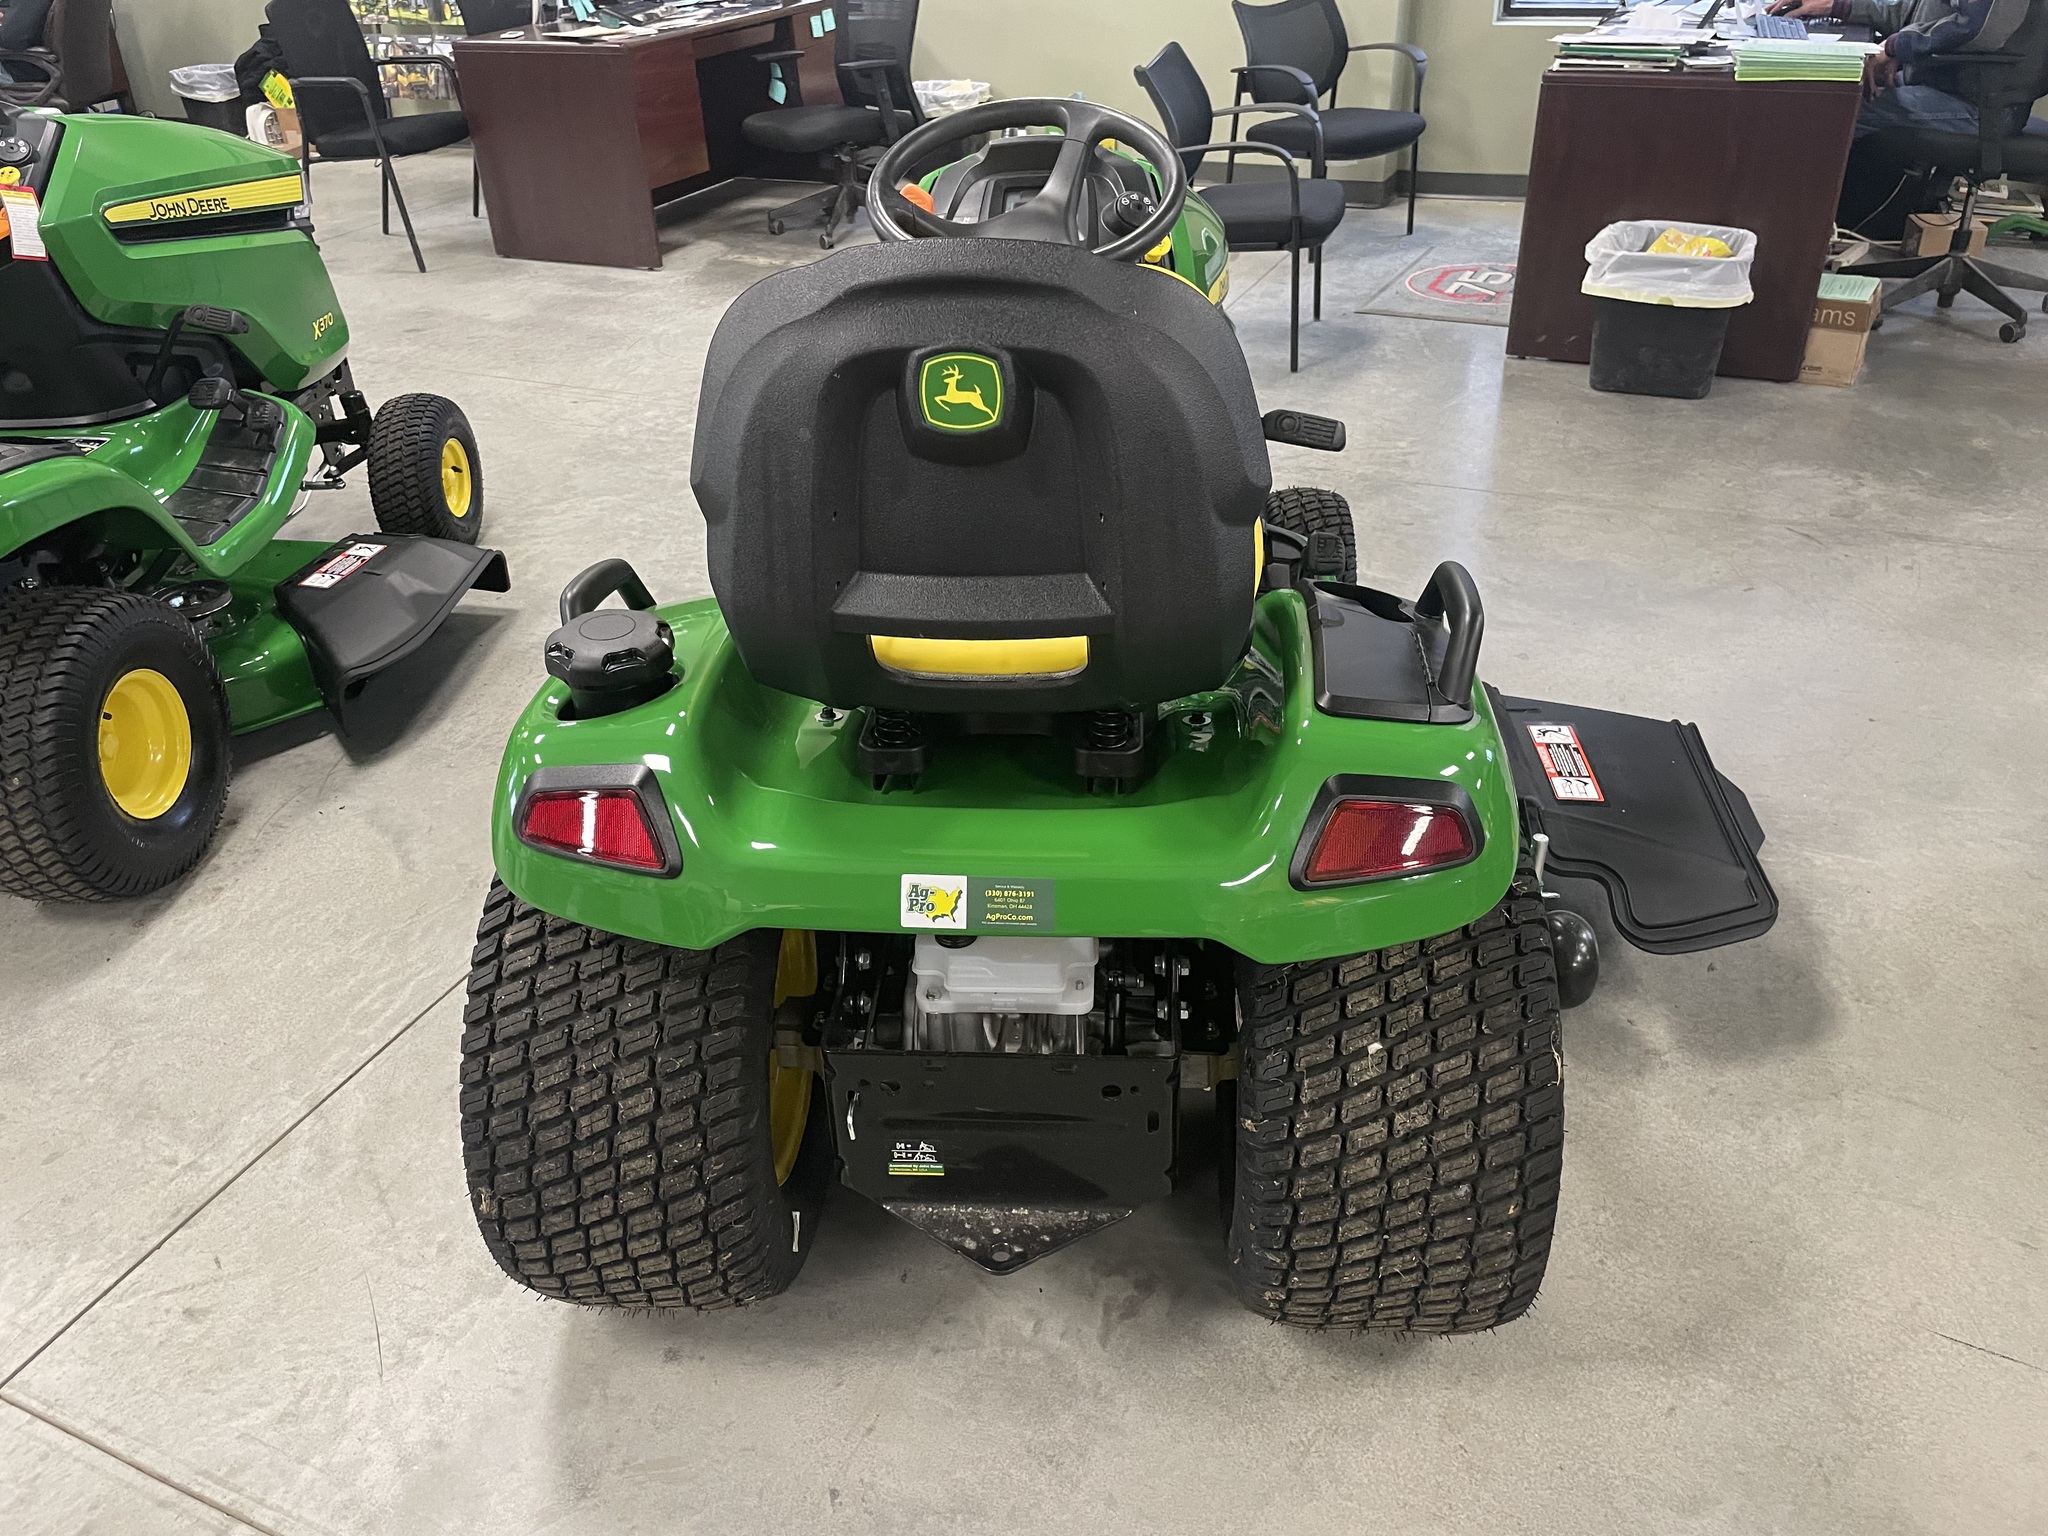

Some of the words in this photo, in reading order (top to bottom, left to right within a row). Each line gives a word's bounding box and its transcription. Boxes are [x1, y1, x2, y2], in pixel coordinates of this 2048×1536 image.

[149, 201, 187, 219] JOHN
[187, 197, 230, 214] DEERE
[311, 312, 334, 341] X370
[908, 884, 935, 900] Ag-
[908, 899, 935, 912] Pro
[985, 913, 1034, 921] AgProCo.com
